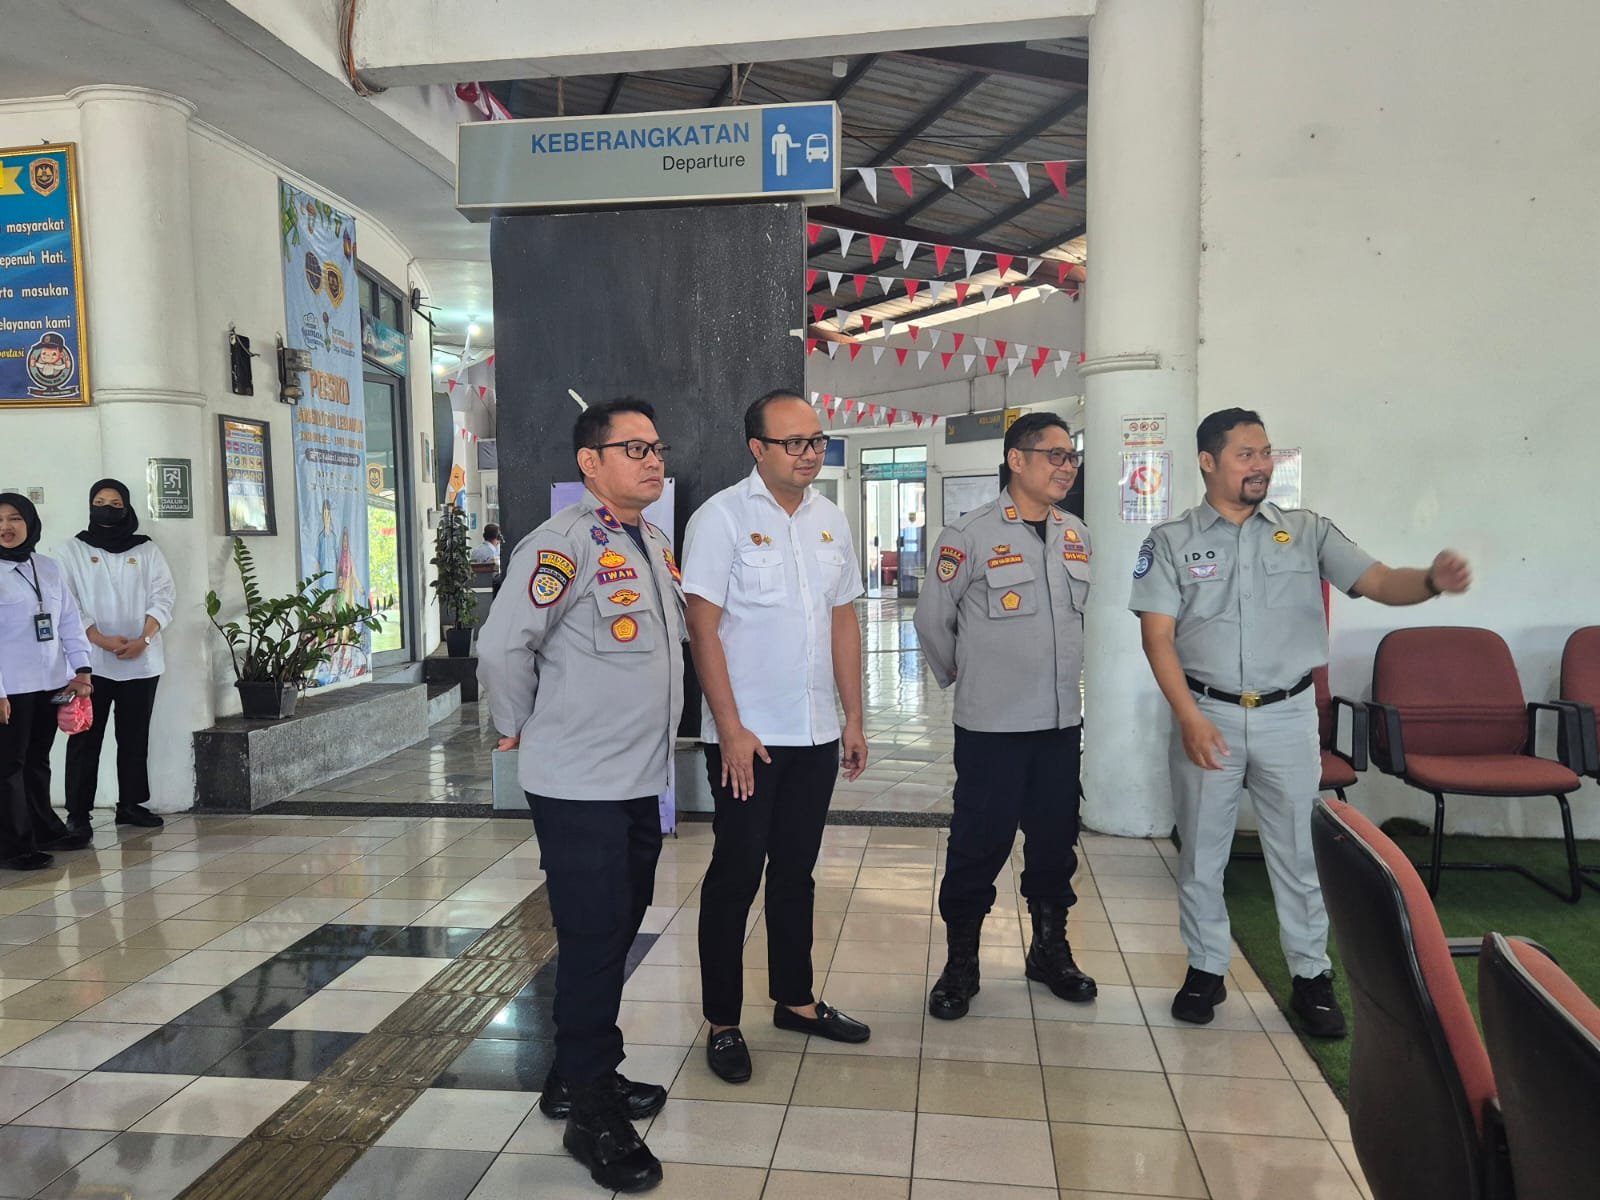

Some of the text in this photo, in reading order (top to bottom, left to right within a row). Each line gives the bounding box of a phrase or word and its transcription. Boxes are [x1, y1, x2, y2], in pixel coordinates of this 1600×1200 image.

[531, 122, 750, 154] KEBERANGKATAN
[662, 152, 746, 173] Departure
[6, 217, 65, 236] masyarakat
[41, 250, 67, 264] Hati.
[22, 282, 69, 297] masukan
[45, 315, 71, 329] kami
[1184, 550, 1216, 563] IDO
[601, 569, 634, 582] IWAN
